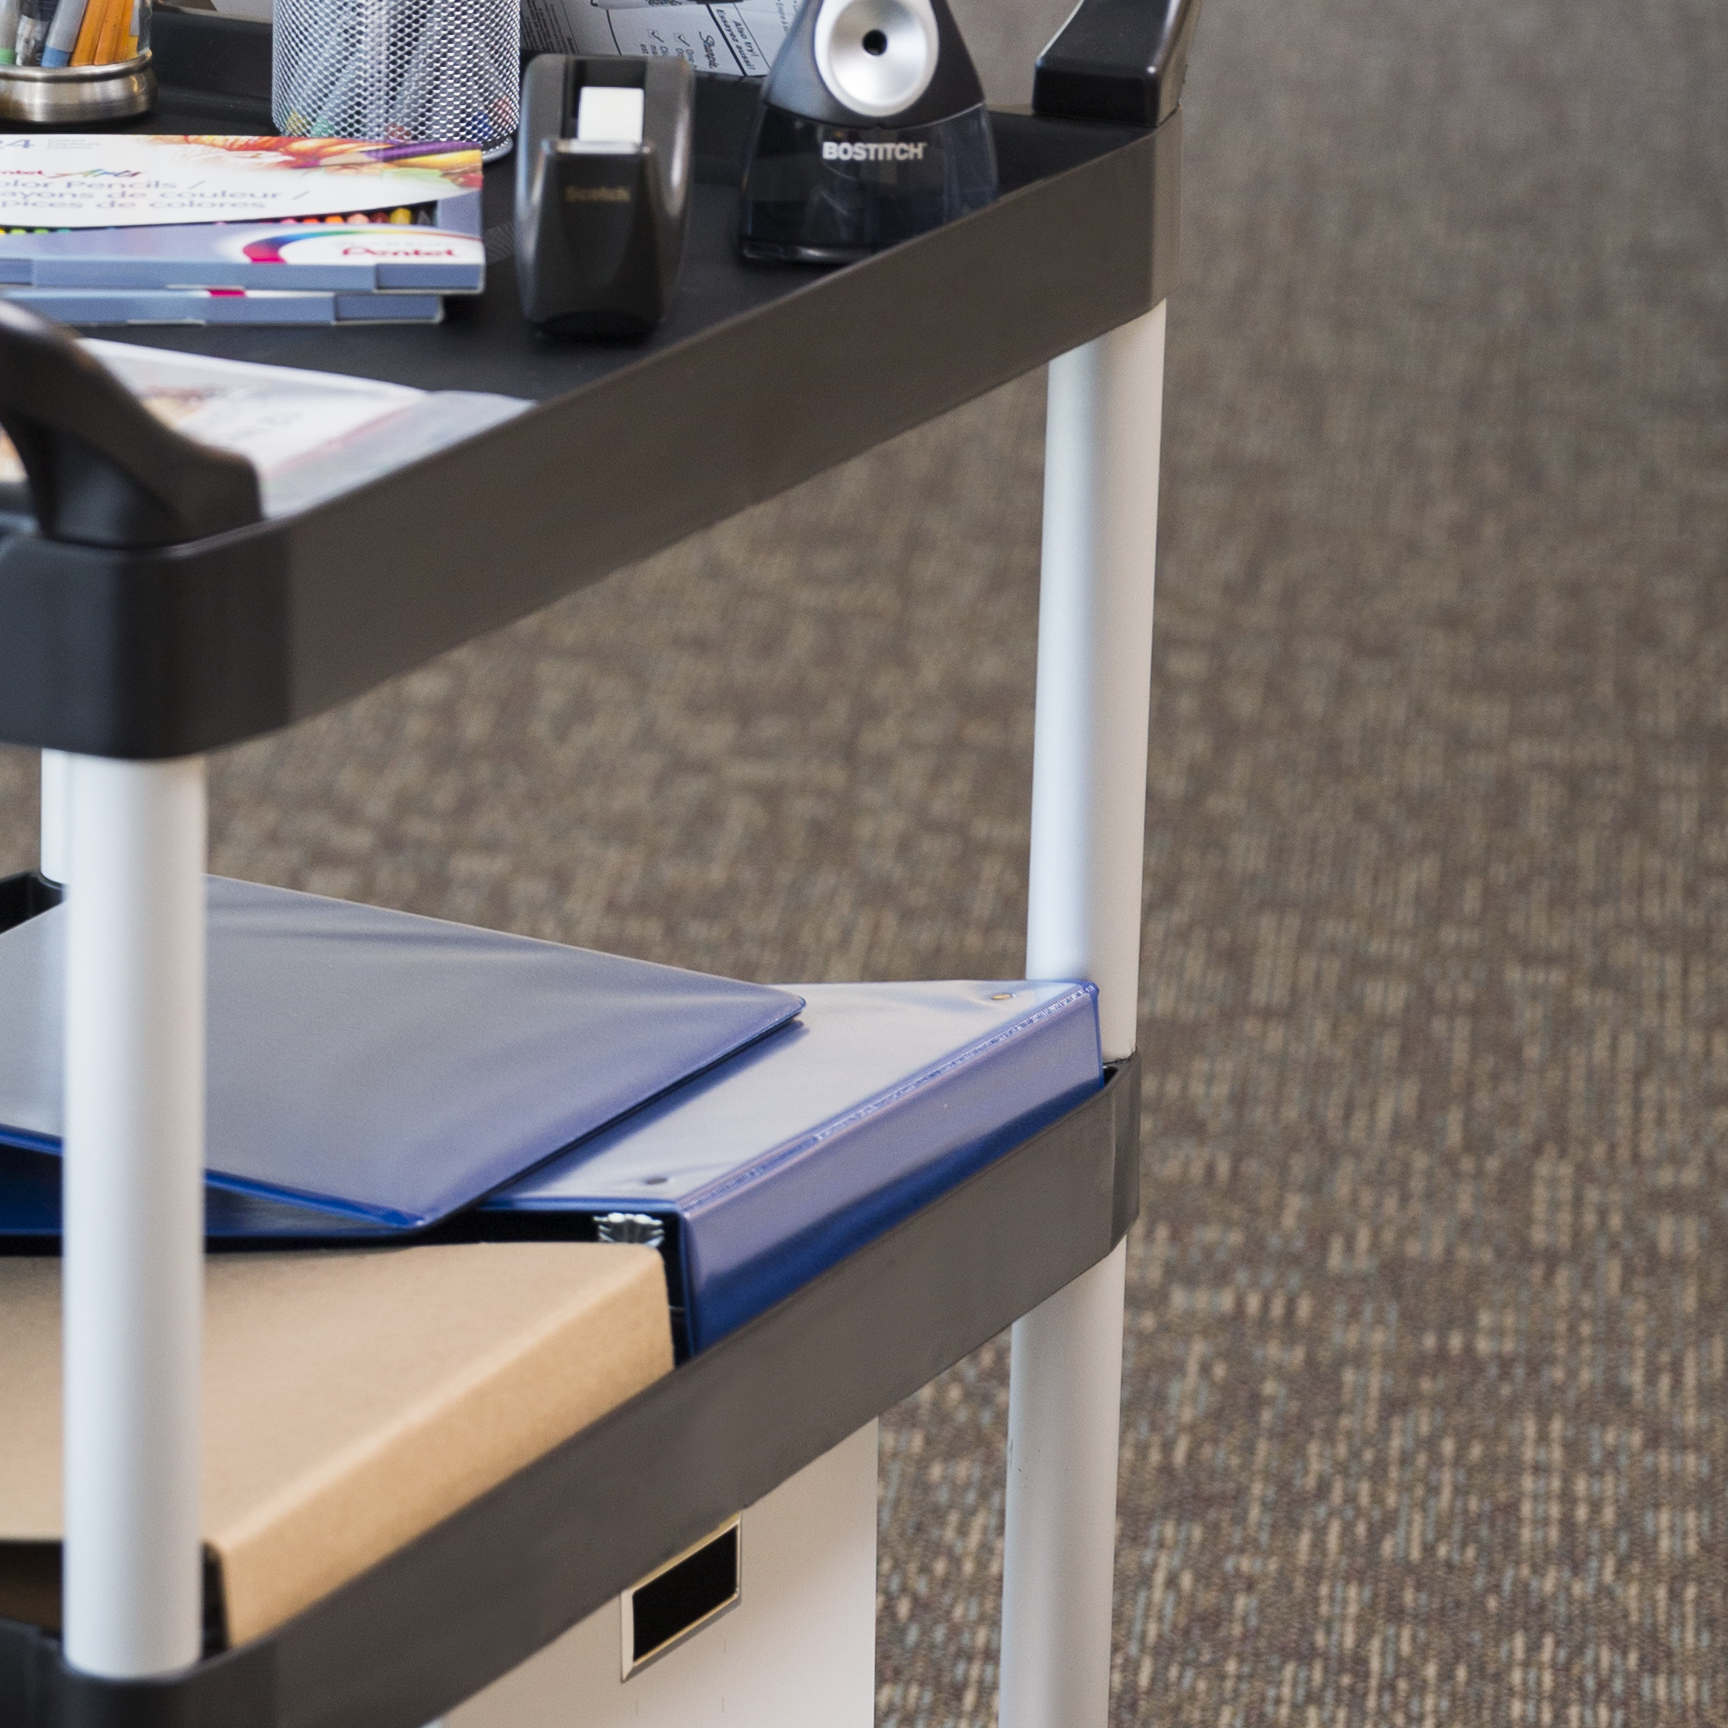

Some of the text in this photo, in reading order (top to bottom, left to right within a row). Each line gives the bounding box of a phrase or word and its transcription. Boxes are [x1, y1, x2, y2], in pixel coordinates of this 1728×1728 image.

[716, 9, 757, 71] Essayez aussi!
[732, 20, 760, 58] Also try!
[821, 141, 924, 161] BOSTITCH
[66, 180, 177, 190] Pencils
[107, 190, 147, 199] de
[159, 190, 282, 200] couleur
[96, 200, 137, 209] de
[149, 200, 266, 209] colores
[342, 246, 455, 257] Pentel
